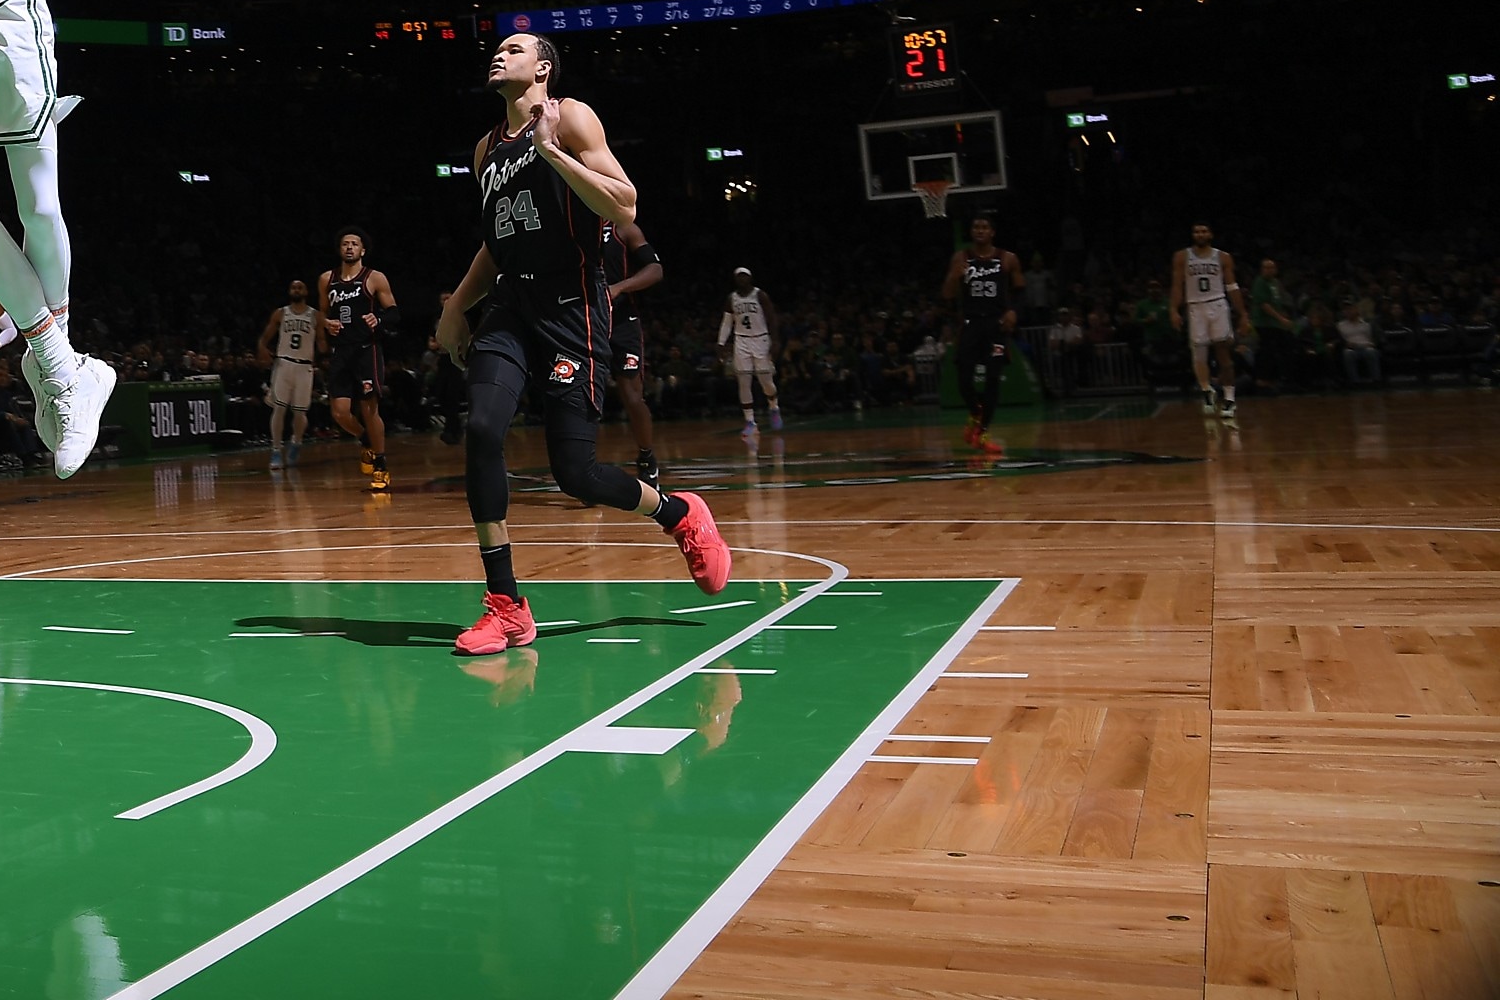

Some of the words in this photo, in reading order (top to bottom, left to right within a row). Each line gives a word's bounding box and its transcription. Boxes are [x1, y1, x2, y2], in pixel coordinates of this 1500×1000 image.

[553, 19, 566, 29] 25
[580, 18, 593, 27] 16
[635, 13, 644, 23] 9
[664, 10, 690, 21] 5/16
[749, 3, 762, 14] 59
[164, 26, 186, 42] TD
[192, 27, 226, 40] Bank
[903, 28, 947, 48] 10:57
[904, 48, 947, 78] 21
[914, 77, 956, 90] TISSOT
[481, 145, 537, 213] Detroit
[495, 189, 541, 239] 24
[971, 280, 997, 297] 23
[1199, 277, 1210, 292] 0
[340, 305, 352, 324] 2
[742, 316, 751, 329] 4
[291, 334, 301, 349] 9
[149, 401, 180, 438] JBL
[188, 399, 217, 435] JBL
